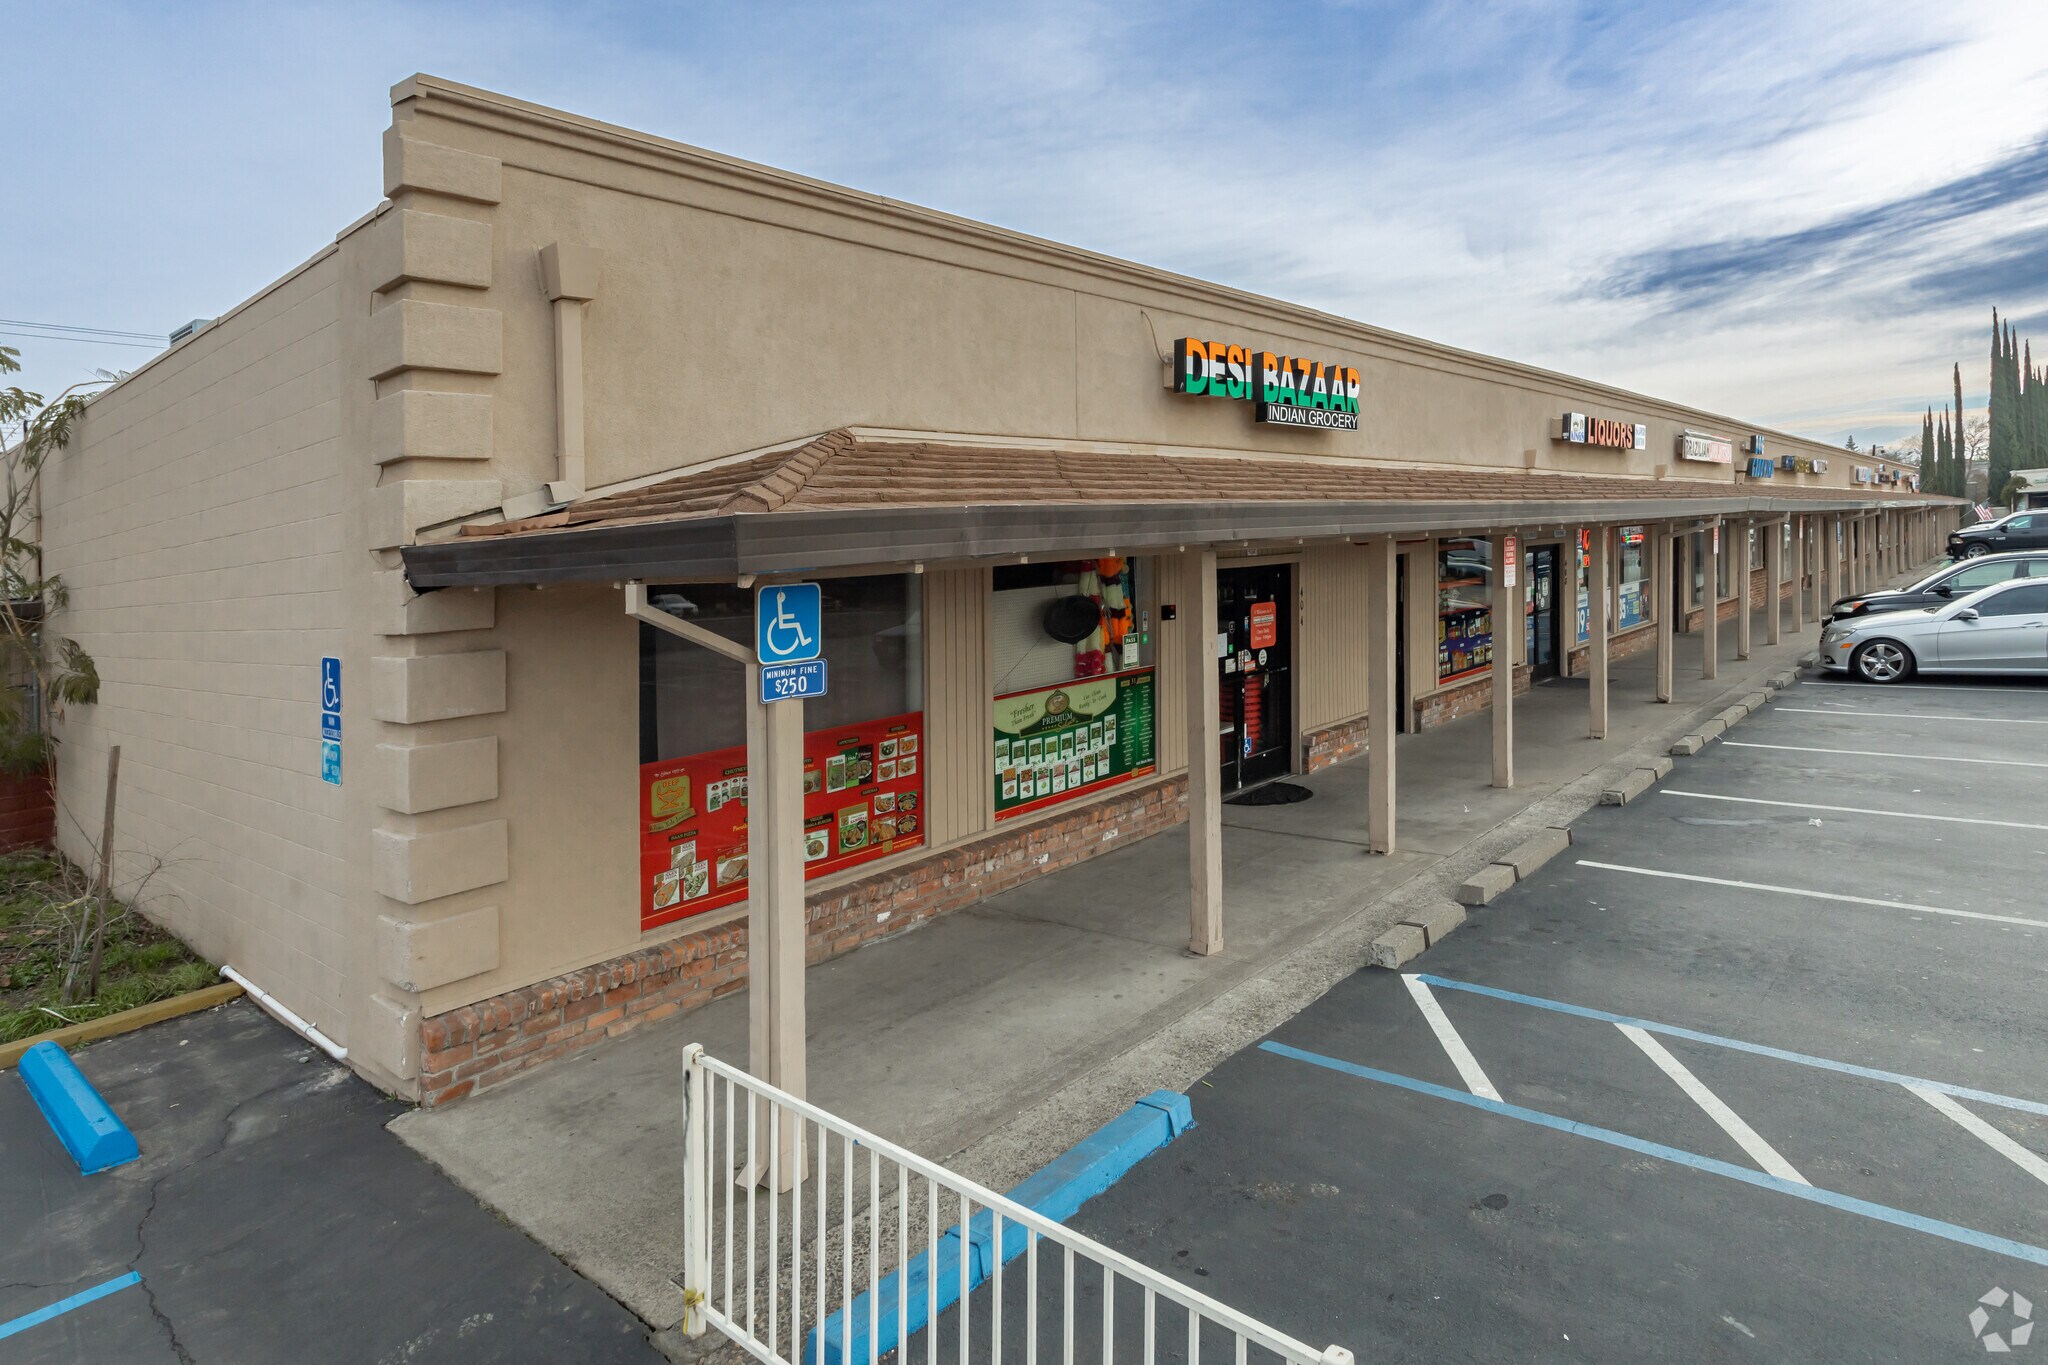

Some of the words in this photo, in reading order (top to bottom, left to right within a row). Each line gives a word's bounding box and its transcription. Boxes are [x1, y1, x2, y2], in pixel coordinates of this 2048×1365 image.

[1186, 337, 1253, 400] DESI
[1263, 352, 1360, 415] BAZAAR
[1268, 405, 1306, 424] INDIAN
[1308, 410, 1358, 429] GROCERY
[1588, 416, 1633, 449] LIQUORS
[767, 668, 796, 679] MINIMUM
[800, 665, 818, 675] FINE
[775, 675, 807, 695] $250
[1042, 712, 1073, 726] PREMIUM
[662, 780, 680, 788] DEEP
